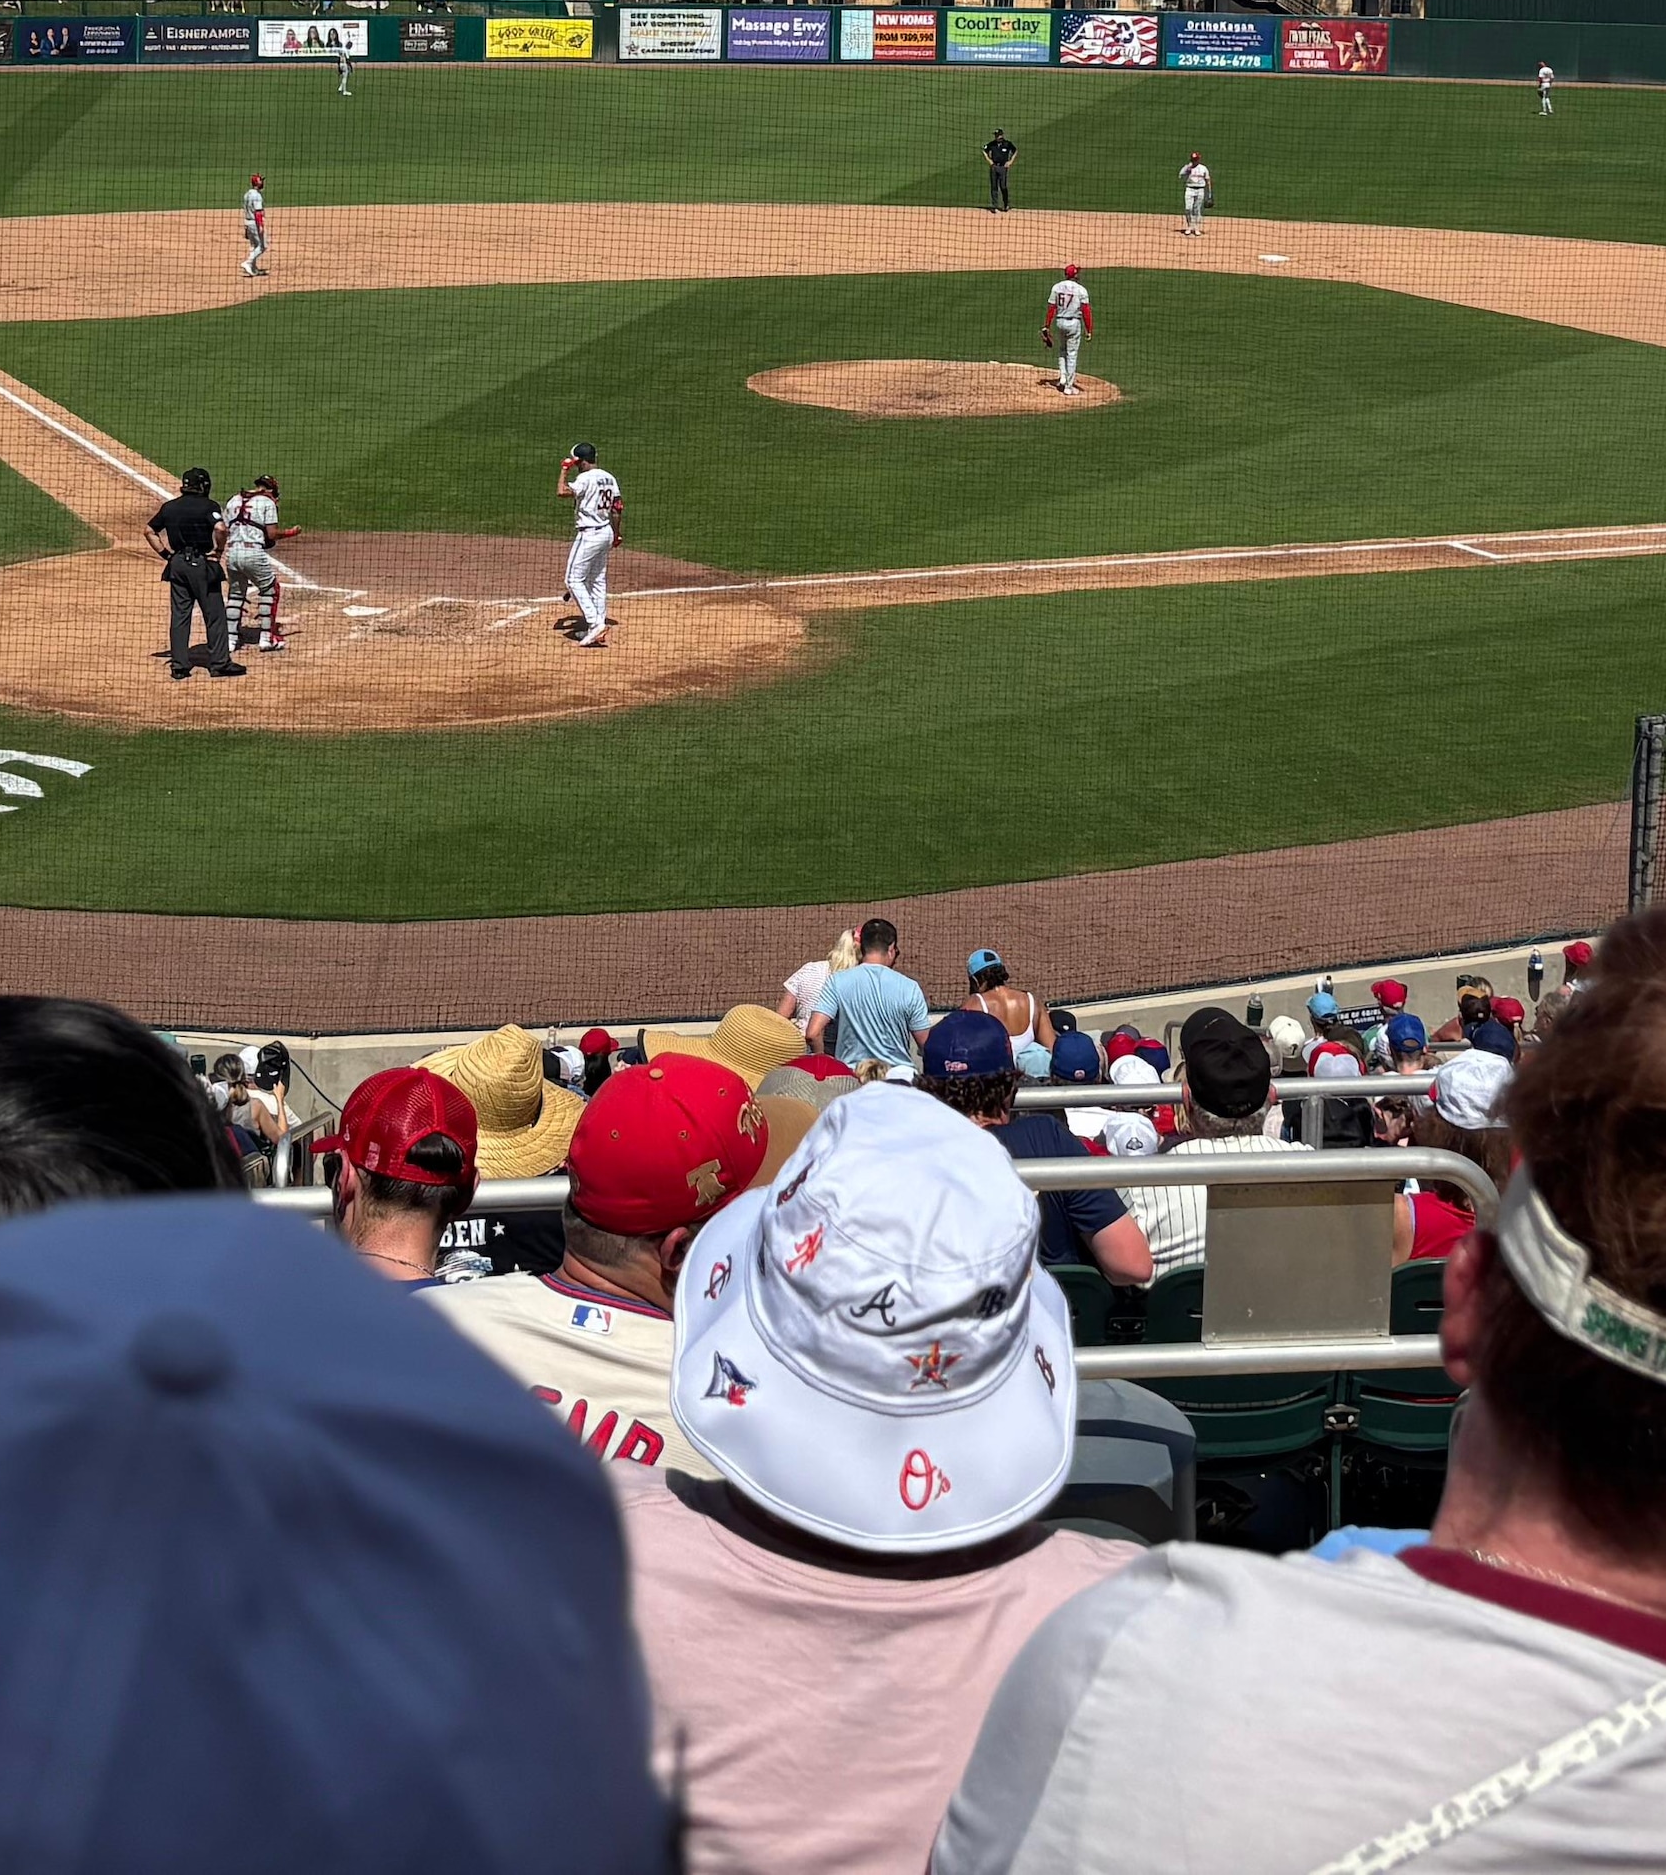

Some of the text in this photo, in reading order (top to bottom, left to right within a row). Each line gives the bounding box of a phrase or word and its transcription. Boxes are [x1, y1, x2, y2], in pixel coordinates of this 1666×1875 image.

[875, 15, 934, 25] NEW HOMES
[1187, 21, 1255, 31] OrthoKagan
[167, 27, 250, 40] EISNERAMPER
[499, 27, 525, 38] GOOD
[732, 18, 790, 35] Massage
[793, 18, 826, 37] Envy
[875, 33, 898, 41] FROM
[1178, 55, 1261, 67] 239-936-6778
[1058, 293, 1073, 308] 67
[597, 489, 612, 509] 38
[850, 1281, 896, 1326] A
[1582, 1301, 1651, 1360] SPRING
